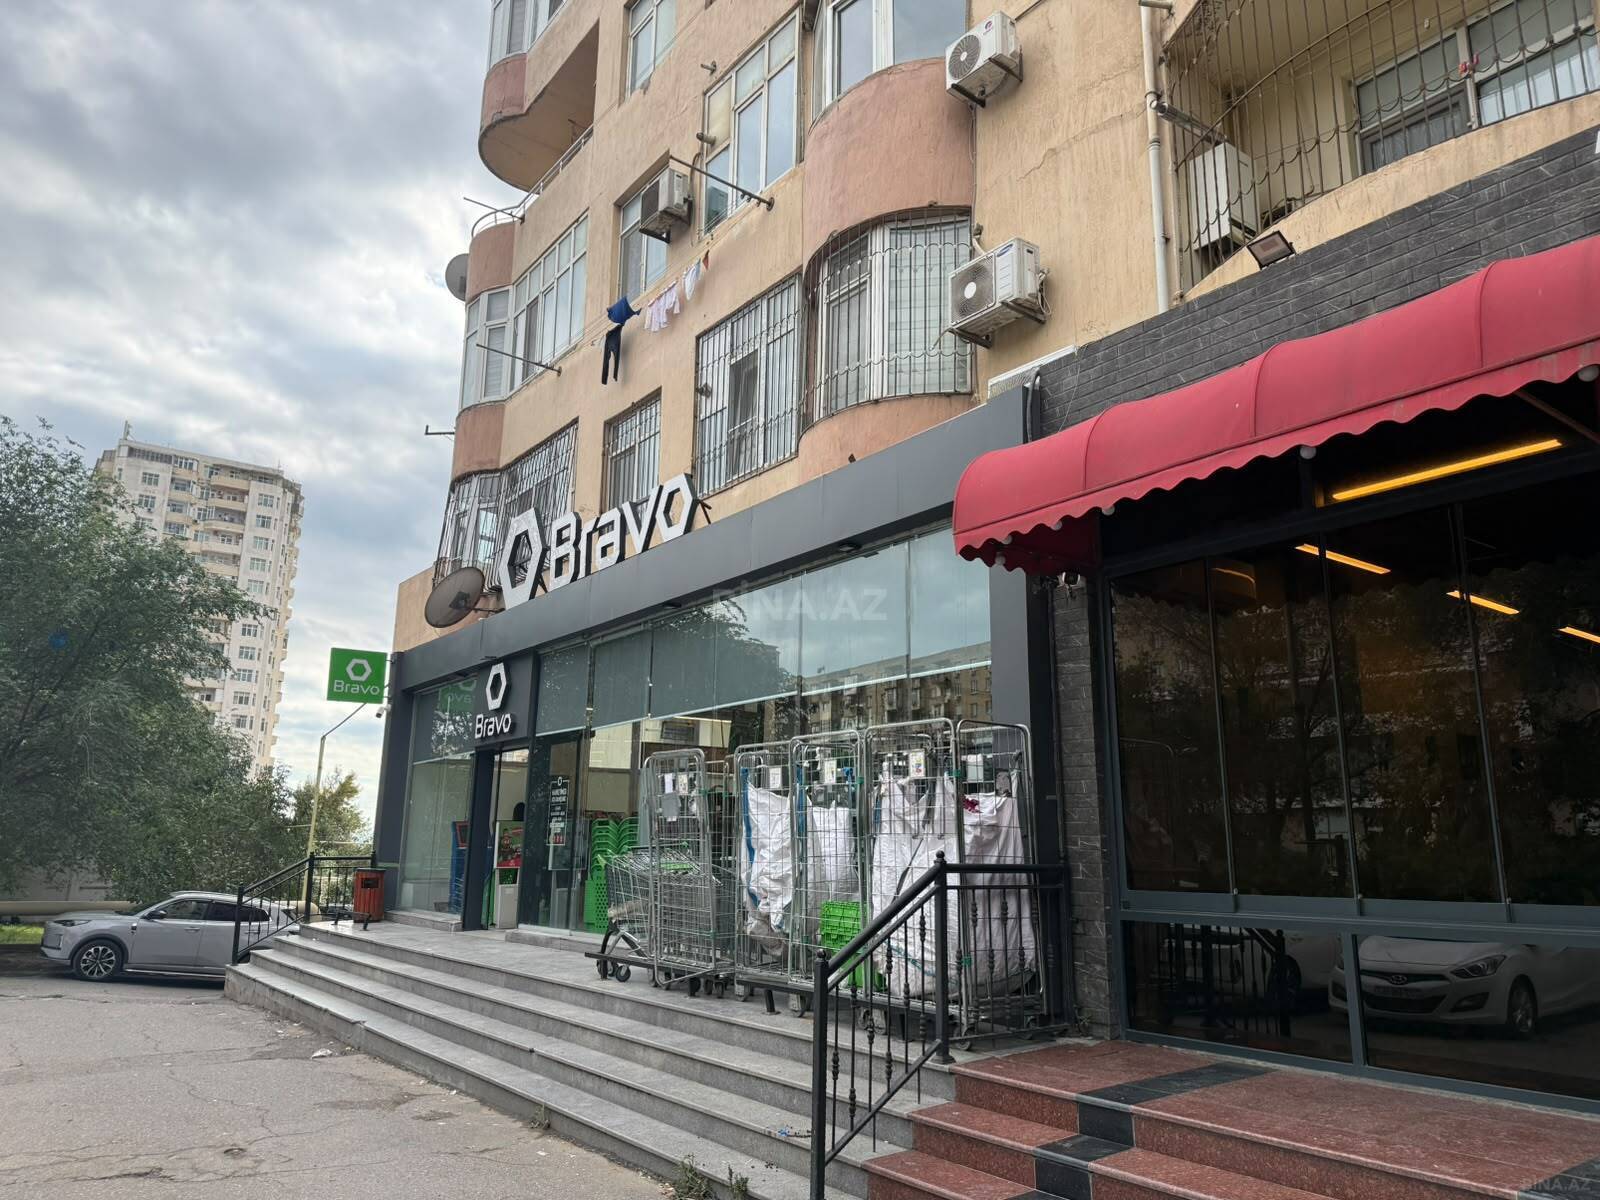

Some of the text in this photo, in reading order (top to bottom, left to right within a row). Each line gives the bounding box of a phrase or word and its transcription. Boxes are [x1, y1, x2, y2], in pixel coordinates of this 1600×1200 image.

[549, 473, 696, 592] Bravo
[333, 679, 380, 695] Bravo
[475, 713, 512, 739] Bravo
